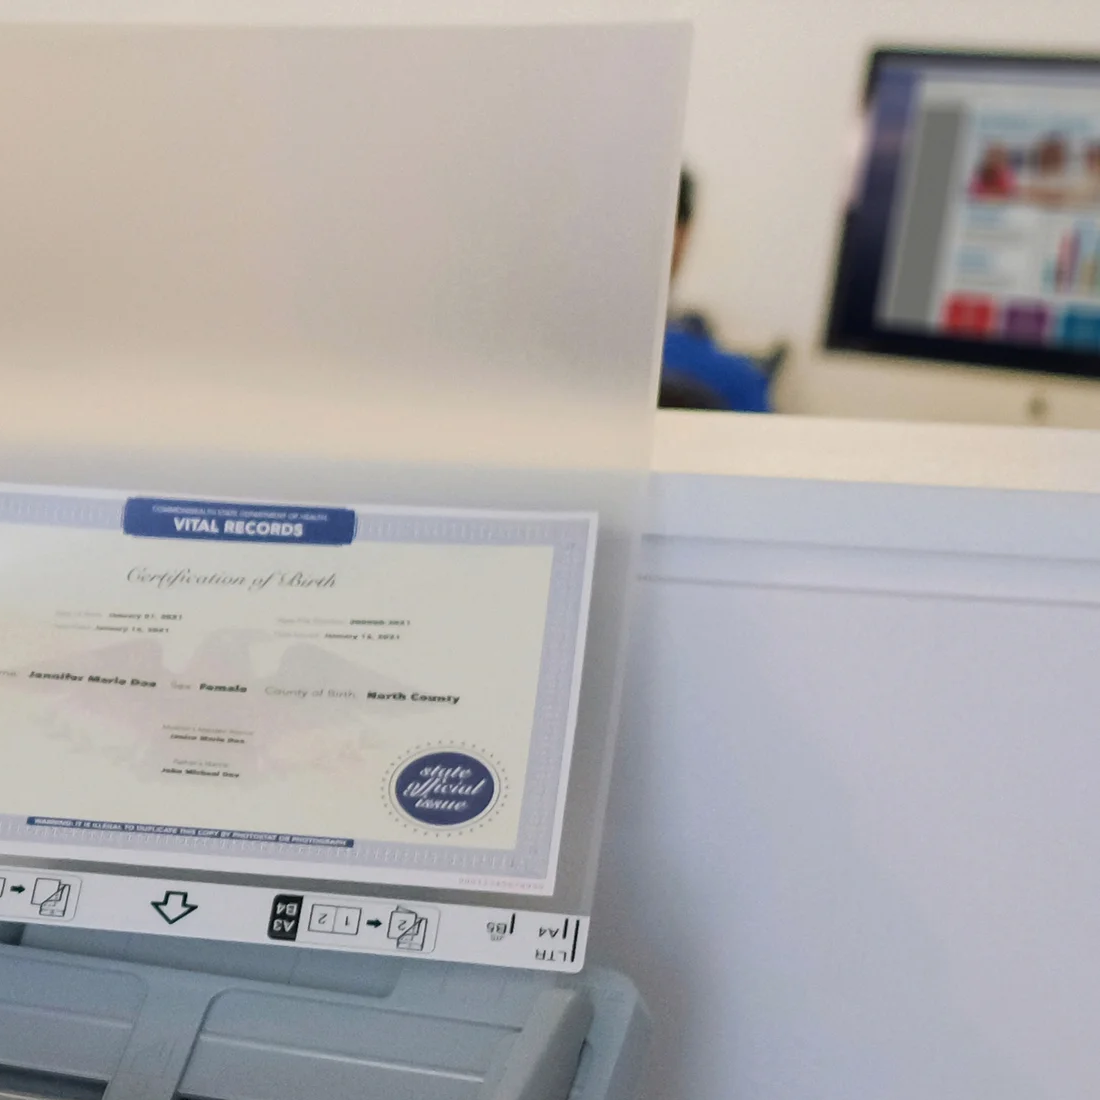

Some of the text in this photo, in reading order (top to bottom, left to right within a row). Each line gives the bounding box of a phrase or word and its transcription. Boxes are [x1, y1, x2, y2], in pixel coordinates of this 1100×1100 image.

[173, 516, 304, 538] VITAL RECORDS
[126, 566, 337, 591] Certification of Birth
[403, 777, 486, 798] official
[415, 798, 468, 811] issue
[275, 902, 298, 916] B4
[272, 918, 295, 932] A3
[317, 912, 328, 925] 2
[486, 922, 507, 934] B5
[539, 927, 560, 938] A4
[535, 949, 567, 962] LTR
